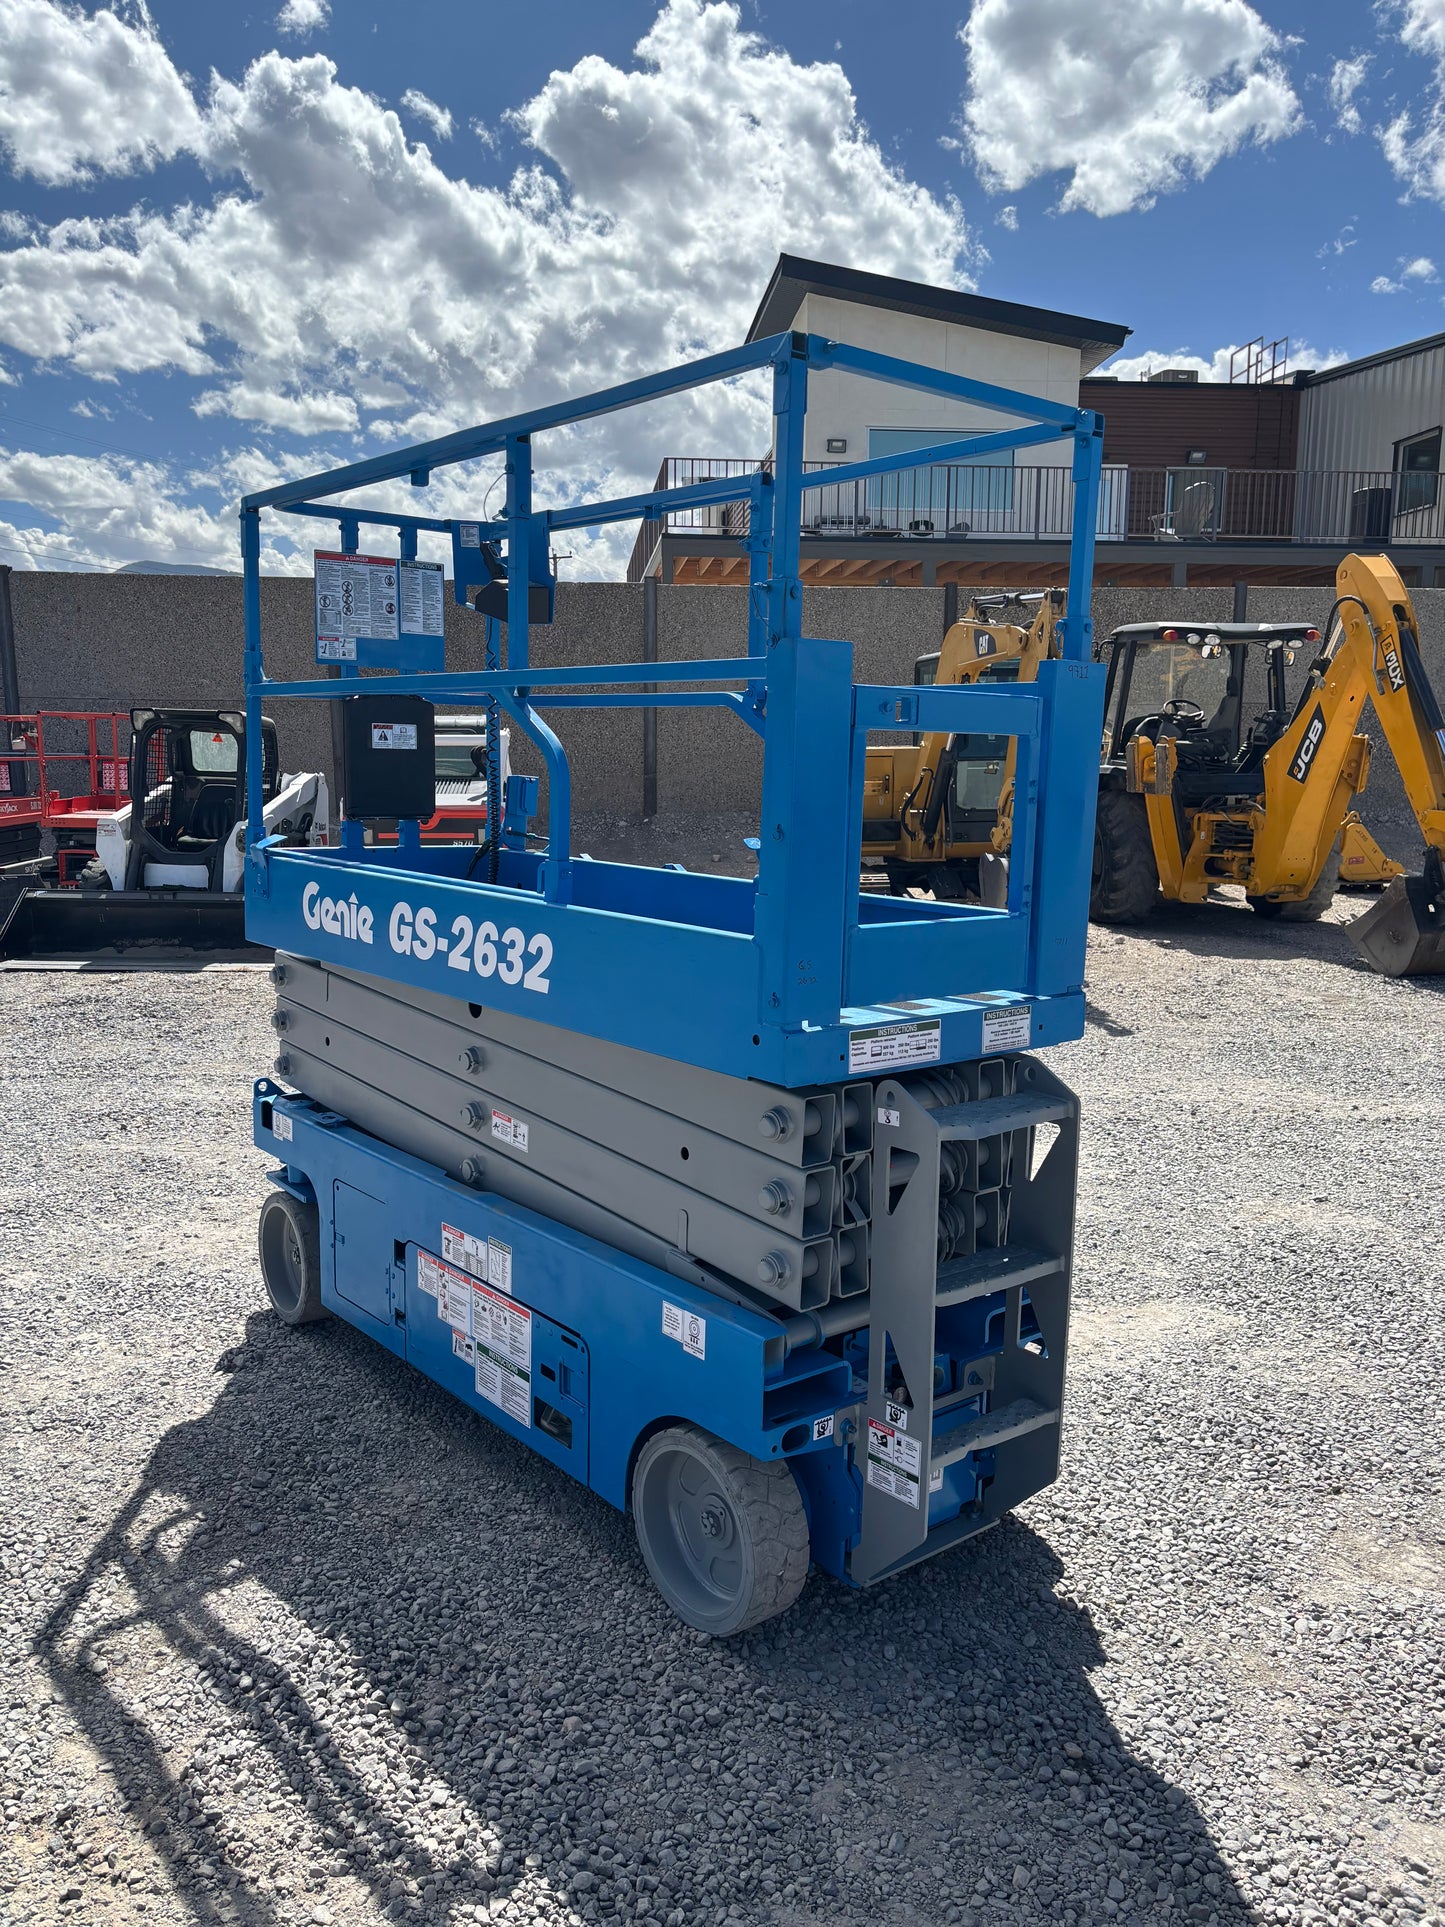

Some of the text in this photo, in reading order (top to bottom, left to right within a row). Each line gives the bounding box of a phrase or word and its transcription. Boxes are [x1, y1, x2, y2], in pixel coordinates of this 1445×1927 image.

[406, 562, 438, 571] INSTRUCTIONS
[979, 635, 989, 655] CAT
[1068, 664, 1089, 679] 9711
[1385, 650, 1405, 690] 3CX
[1297, 718, 1323, 780] JCB
[302, 881, 553, 994] Genie GS-2632
[986, 1006, 1029, 1020] INSTRUCTIONS
[877, 1024, 918, 1036] INSTRUCTIONS
[488, 1350, 519, 1374] INSTRUCTIONS
[876, 1422, 893, 1435] DANGER
[880, 1459, 908, 1478] INSTRUCTIONS
